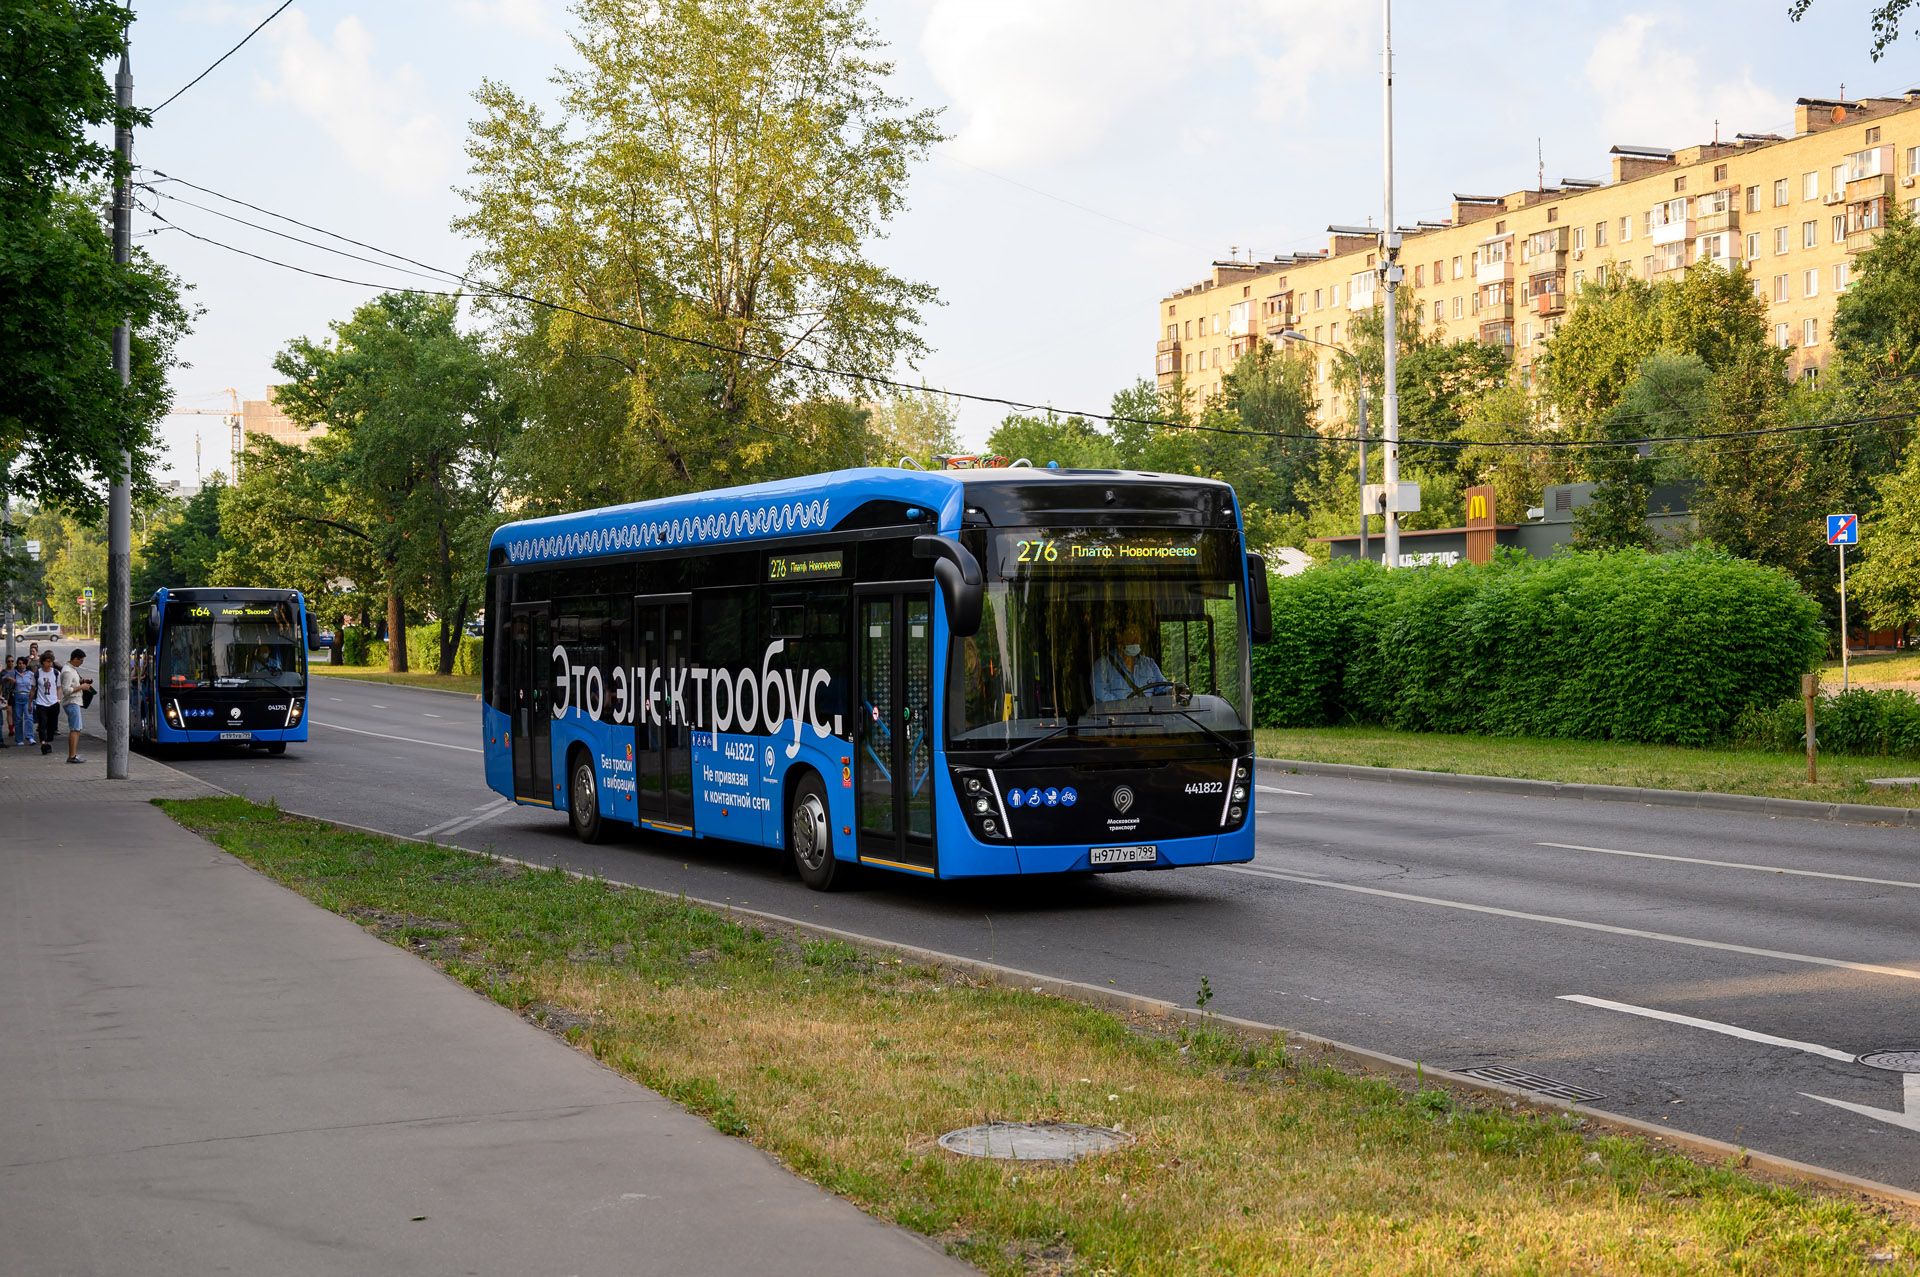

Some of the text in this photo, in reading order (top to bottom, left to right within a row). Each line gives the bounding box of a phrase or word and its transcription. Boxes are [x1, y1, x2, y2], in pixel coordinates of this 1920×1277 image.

[1016, 540, 1197, 562] 276 Платф. Новогиреево
[770, 558, 787, 578] 276
[552, 638, 843, 759] Это электробус.
[724, 741, 755, 762] 441822
[601, 754, 612, 769] Без
[612, 758, 633, 774] тряски
[606, 774, 636, 793] вибраций
[703, 765, 714, 781] Не
[714, 769, 749, 787] привязан
[1184, 782, 1223, 794] 441822
[704, 790, 771, 812] к контактной сети
[1137, 846, 1153, 857] 799
